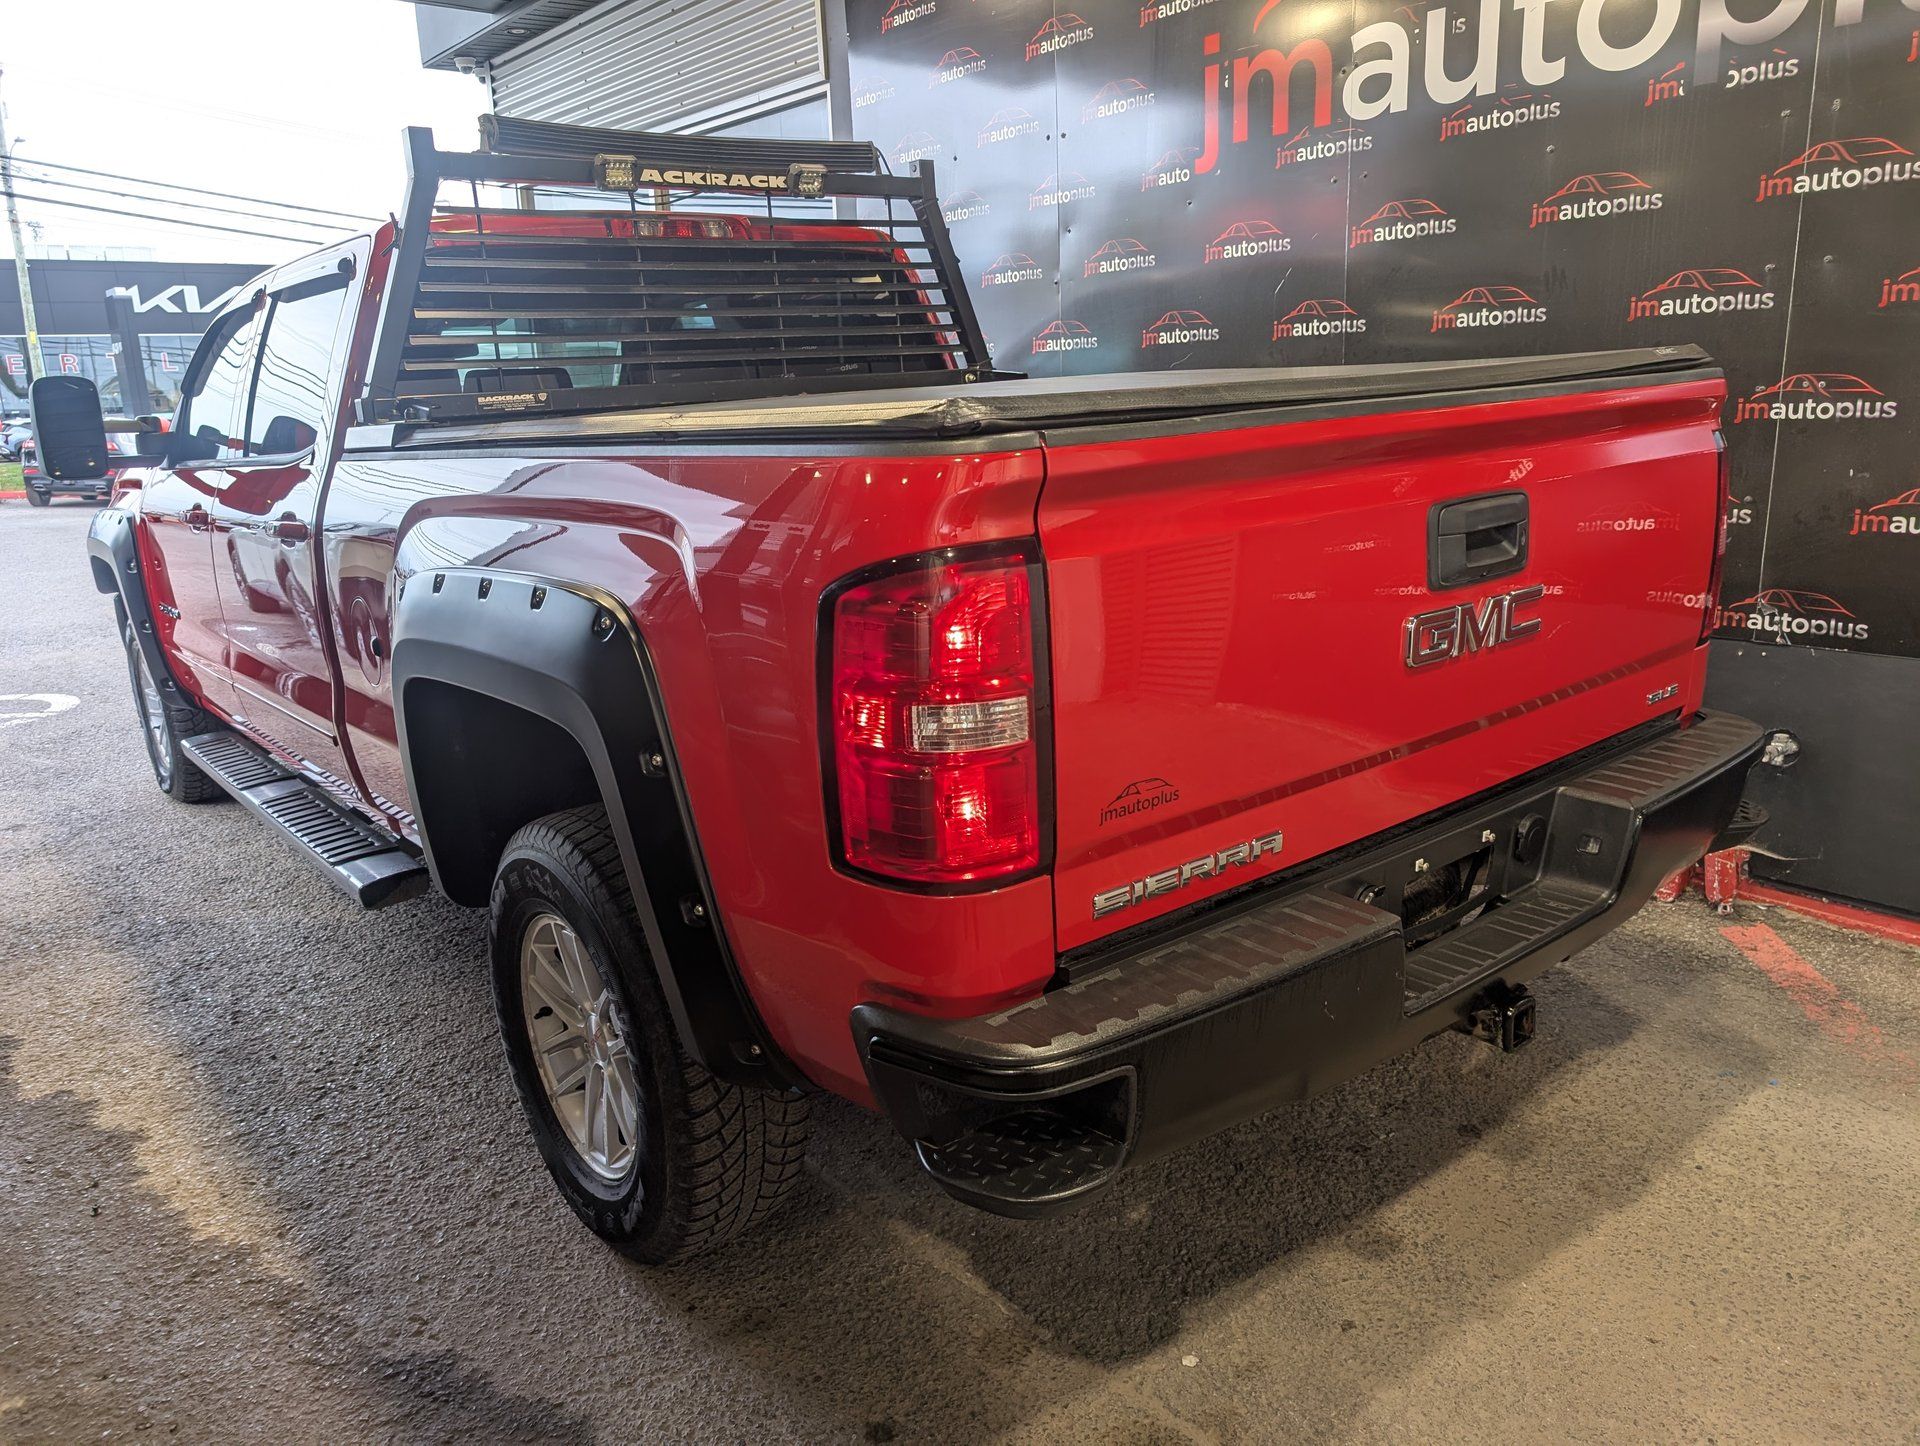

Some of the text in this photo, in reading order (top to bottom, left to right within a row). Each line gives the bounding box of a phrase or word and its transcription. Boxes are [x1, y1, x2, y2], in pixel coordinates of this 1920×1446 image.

[881, 1, 936, 34] jmautoplus
[1025, 26, 1094, 61] jmautoplus
[928, 59, 986, 89] jmautoplus
[1082, 93, 1155, 124] jmautoplus
[1440, 101, 1561, 141] jmautoplus
[977, 120, 1039, 148] jmautoplus
[1275, 135, 1373, 169] jmautoplus
[640, 169, 787, 188] ACKRACK
[1029, 185, 1096, 210] jmautoplus
[1529, 191, 1663, 228] jmautoplus
[1350, 217, 1457, 248] jmautoplus
[1204, 237, 1291, 263] jmautoplus
[981, 268, 1043, 288] jmautoplus
[1084, 254, 1156, 278] jmautoplus
[1431, 306, 1547, 333] jmautoplus
[1628, 291, 1775, 321] jmautoplus
[1142, 326, 1219, 348] jmautoplus
[1272, 317, 1367, 341] jmautoplus
[1032, 336, 1098, 354] jmautoplus
[477, 393, 535, 403] BACKRACK
[1734, 398, 1898, 424] jmautoplus
[1404, 584, 1545, 668] GMC
[1713, 606, 1869, 640] jmautoplus
[1099, 788, 1180, 827] jmautoplus
[1092, 829, 1284, 920] SIERRA
